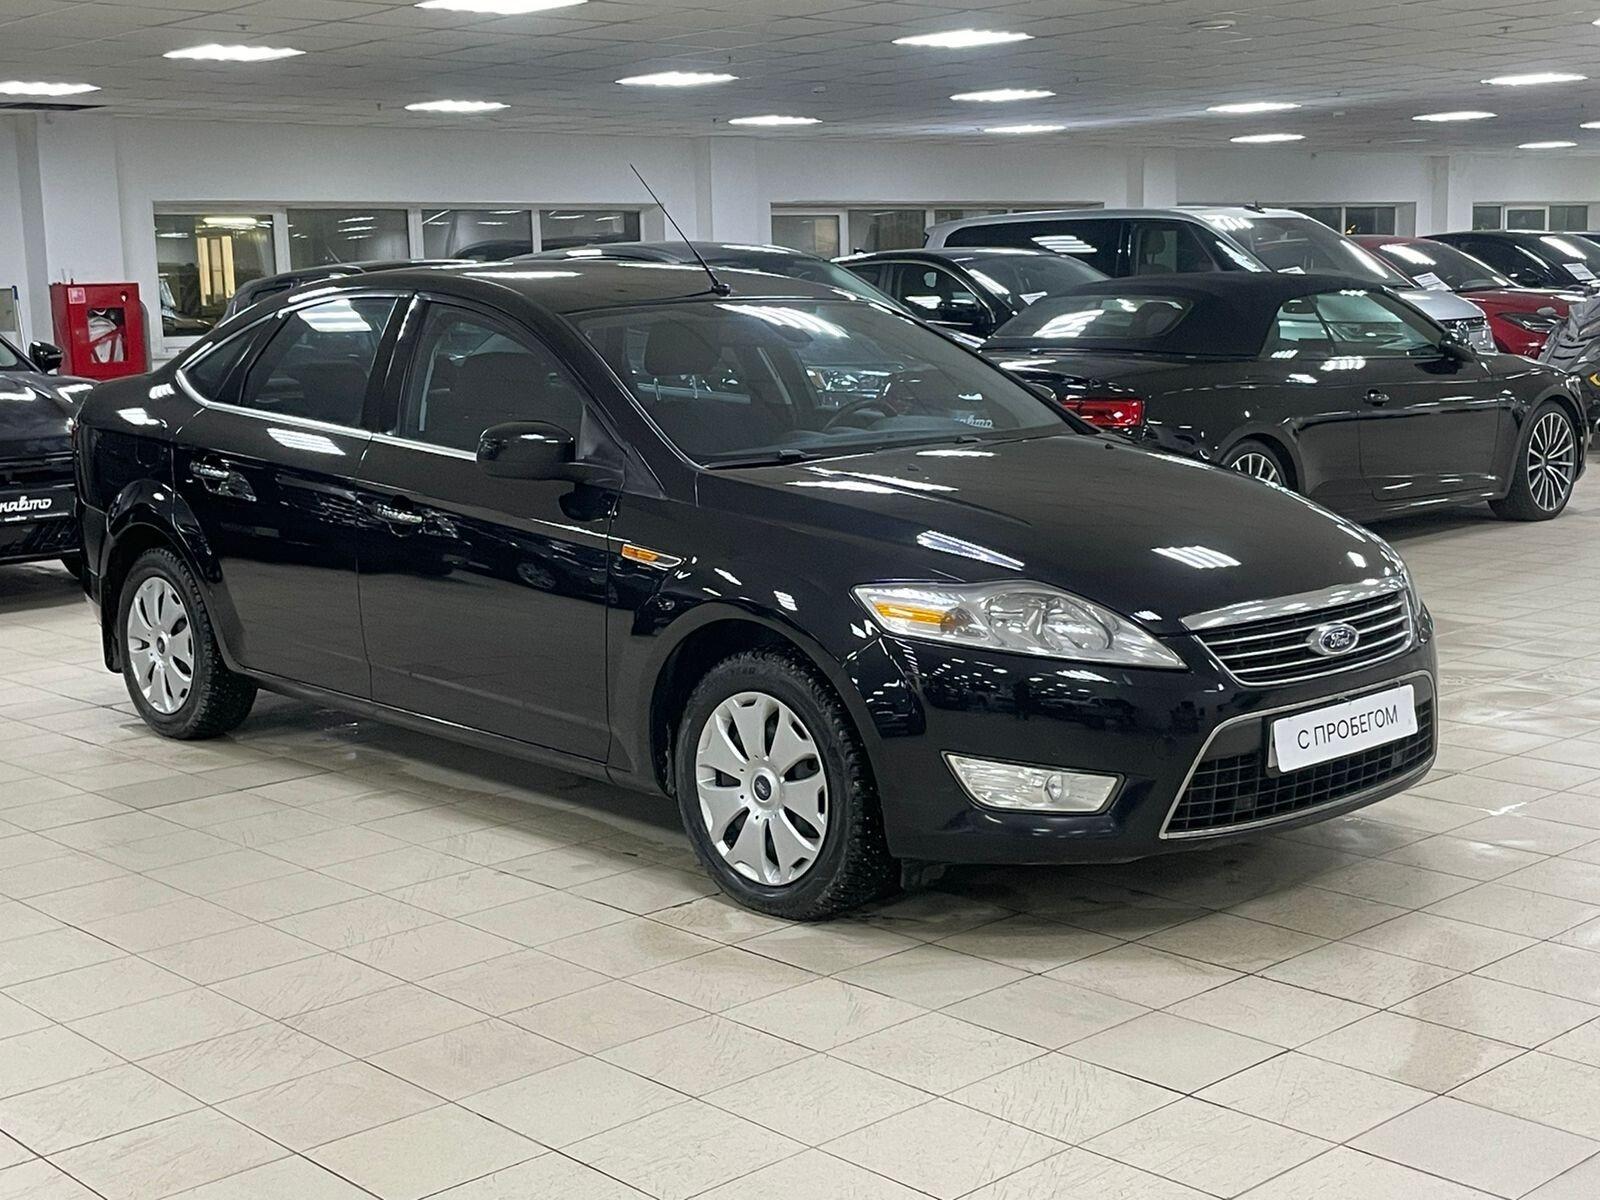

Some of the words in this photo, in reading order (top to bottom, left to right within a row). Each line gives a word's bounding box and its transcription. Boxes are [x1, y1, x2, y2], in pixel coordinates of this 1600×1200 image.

[1329, 630, 1351, 649] Ford
[1297, 729, 1311, 750] С
[1313, 704, 1399, 746] ПРОБЕГОМ
